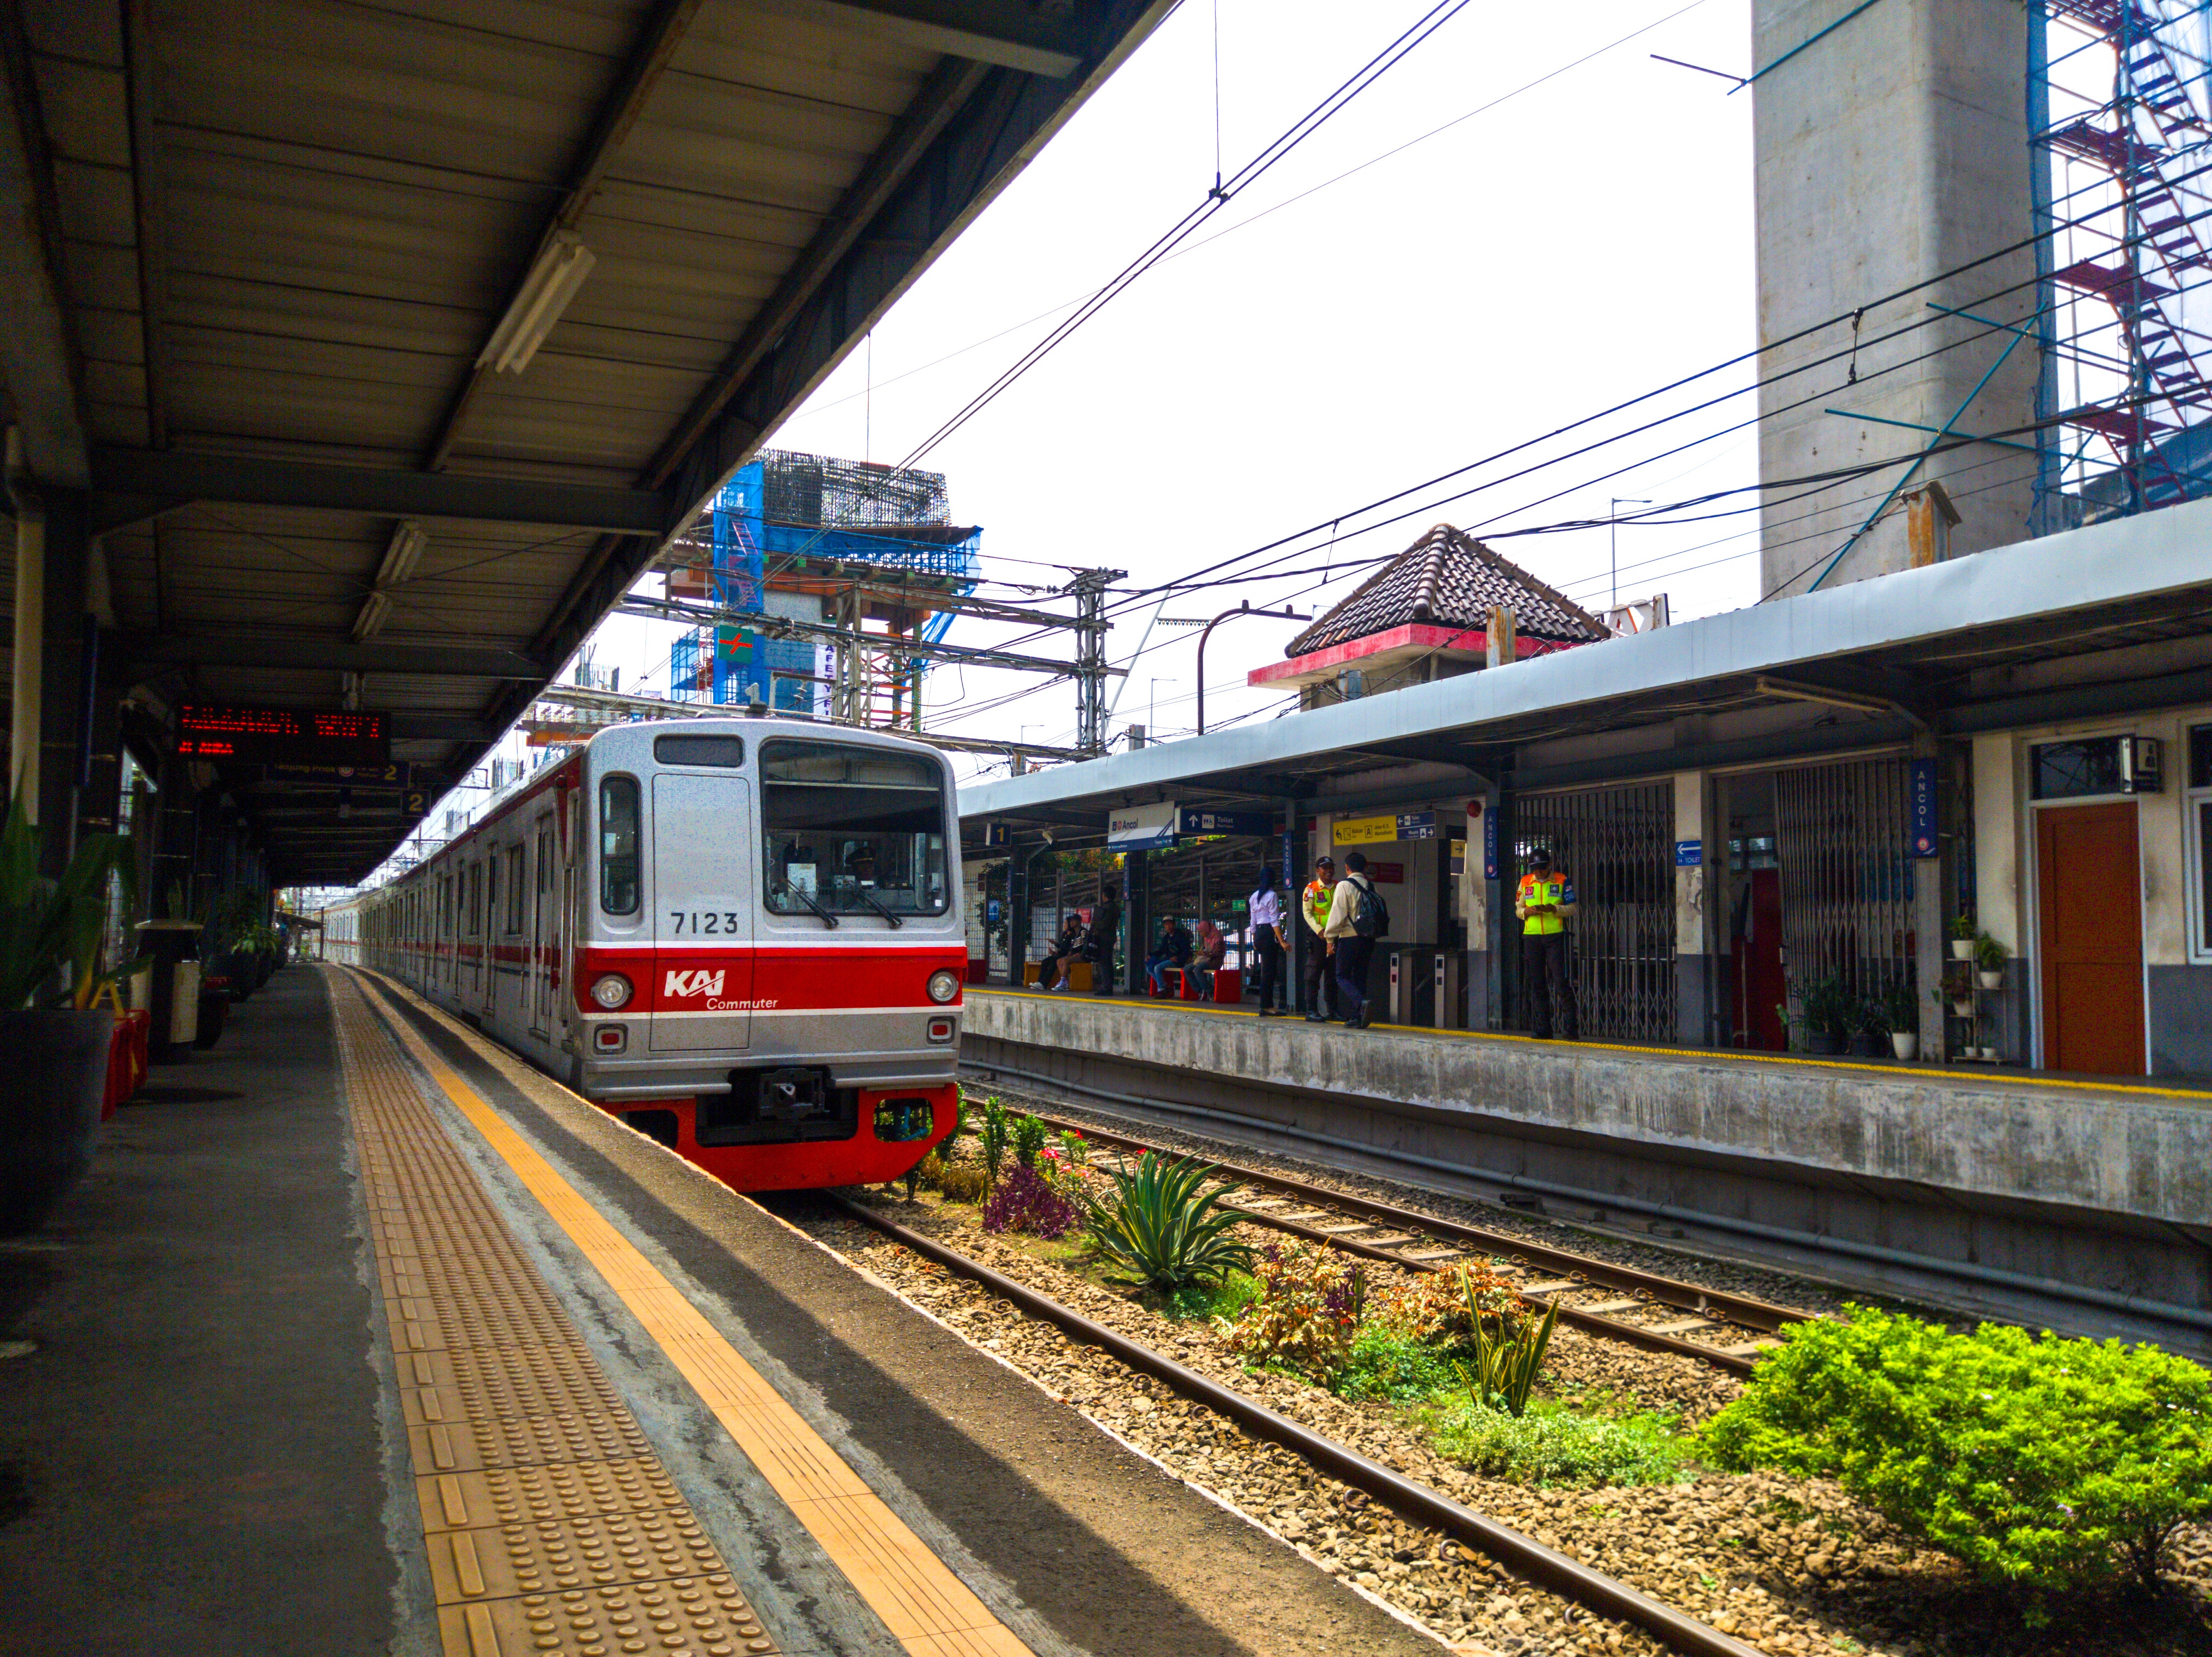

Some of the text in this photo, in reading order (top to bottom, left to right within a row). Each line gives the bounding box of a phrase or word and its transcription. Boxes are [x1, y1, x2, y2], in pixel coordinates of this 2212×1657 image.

[824, 645, 835, 692] AFETY
[384, 765, 397, 780] 2
[409, 794, 422, 811] 2
[1918, 771, 1926, 826] ANCOL
[1122, 818, 1138, 830] Ancol
[1366, 827, 1371, 836] A
[997, 827, 1004, 842] 1
[671, 912, 738, 934] 7123
[664, 969, 726, 997] KAI
[706, 998, 778, 1010] Commuter
